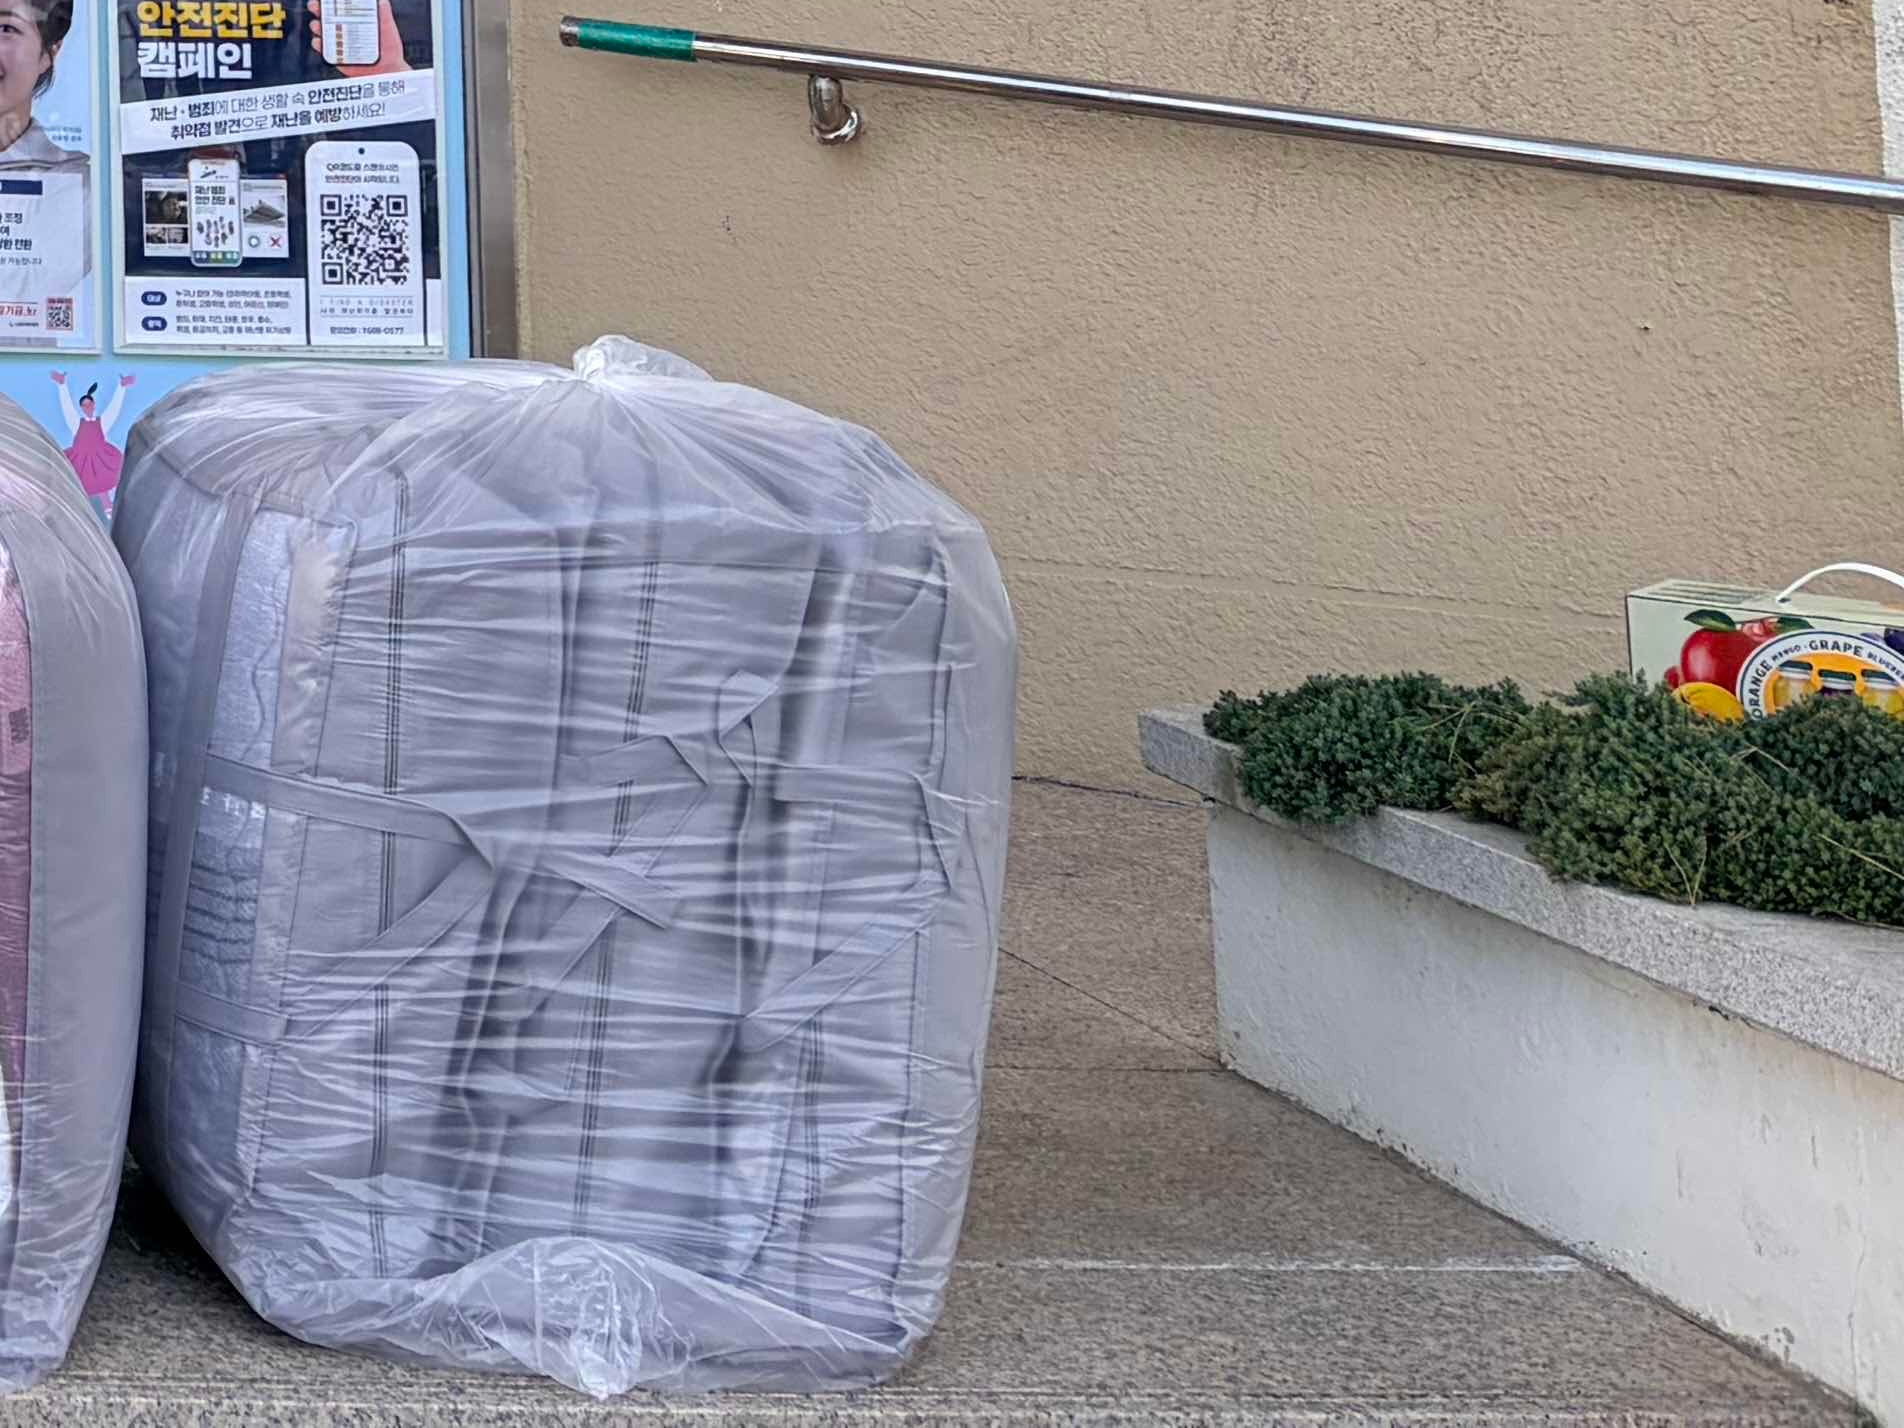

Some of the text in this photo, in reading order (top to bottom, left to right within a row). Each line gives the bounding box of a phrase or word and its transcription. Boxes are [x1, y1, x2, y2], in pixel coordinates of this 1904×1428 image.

[136, 0, 287, 40] 안전진단
[137, 41, 253, 80] 캠페인
[150, 107, 178, 123] 재난
[187, 100, 229, 118] 범죄에
[231, 97, 260, 114] 대한
[261, 93, 289, 111] 생활
[307, 82, 375, 105] 안전진단을
[170, 100, 386, 141] 취약점 발견으로 재난을 예방하세요!
[1748, 659, 1773, 720] ORANGE
[1808, 639, 1864, 656] GRAPE
